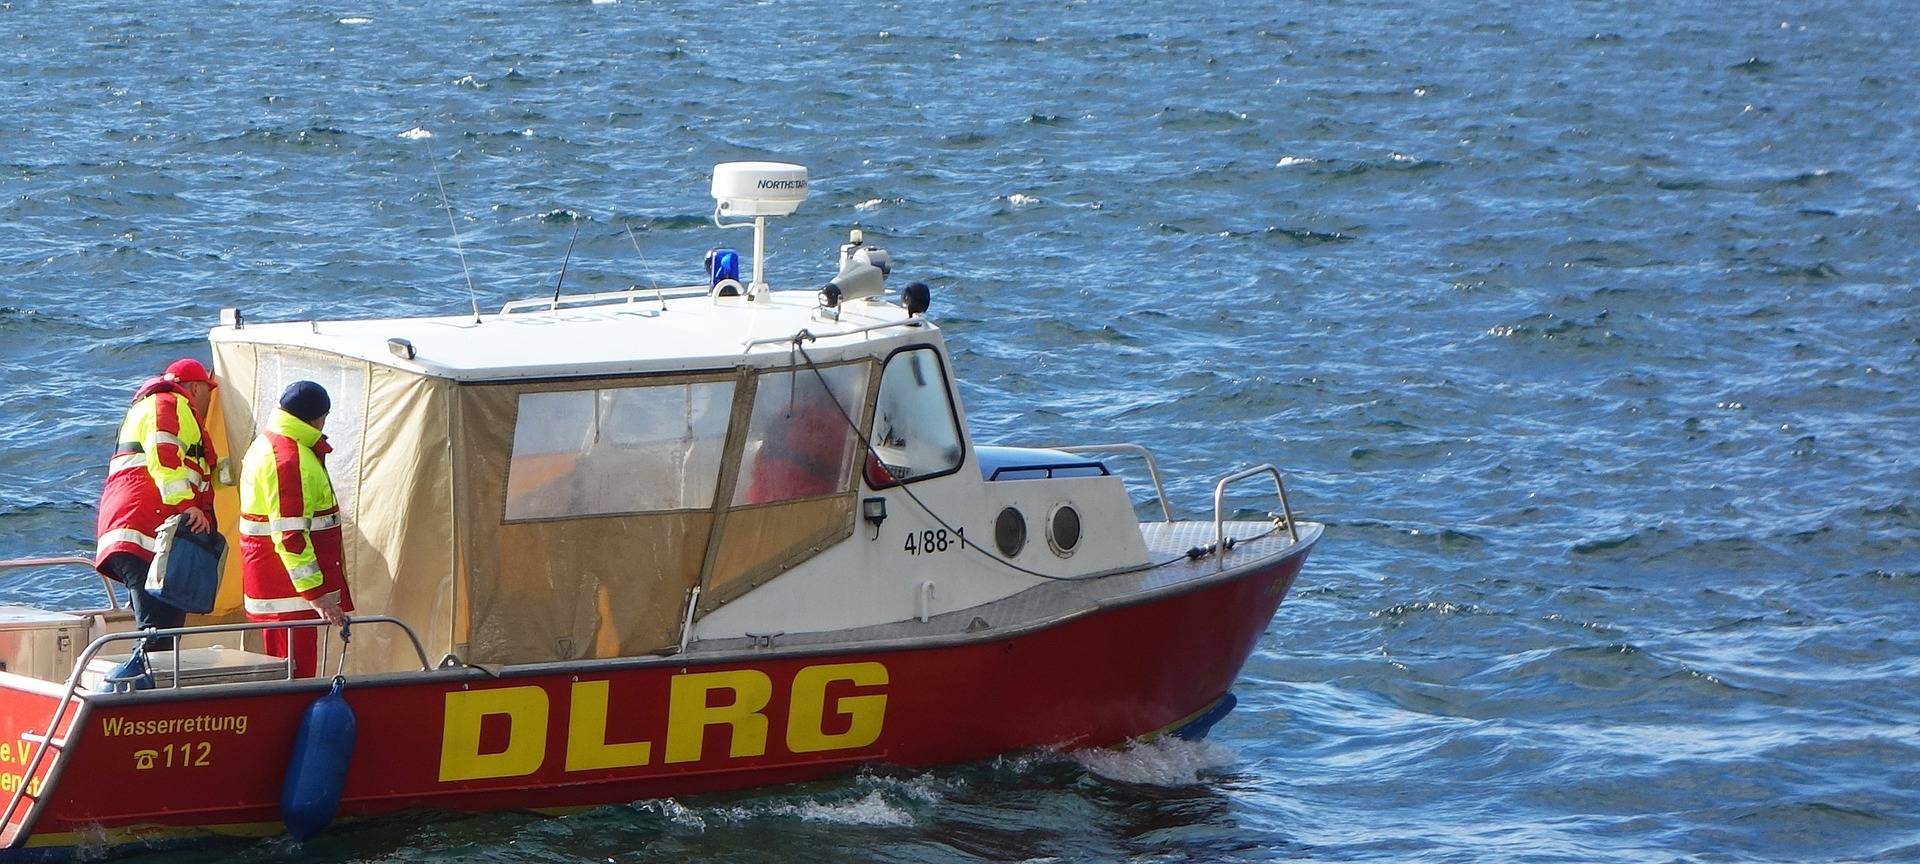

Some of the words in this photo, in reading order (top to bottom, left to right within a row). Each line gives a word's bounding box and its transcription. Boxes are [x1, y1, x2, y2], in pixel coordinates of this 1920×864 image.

[904, 526, 966, 556] 4/88-1
[102, 714, 248, 738] Wasserrettung
[439, 661, 889, 782] DLRG
[158, 741, 212, 769] 112
